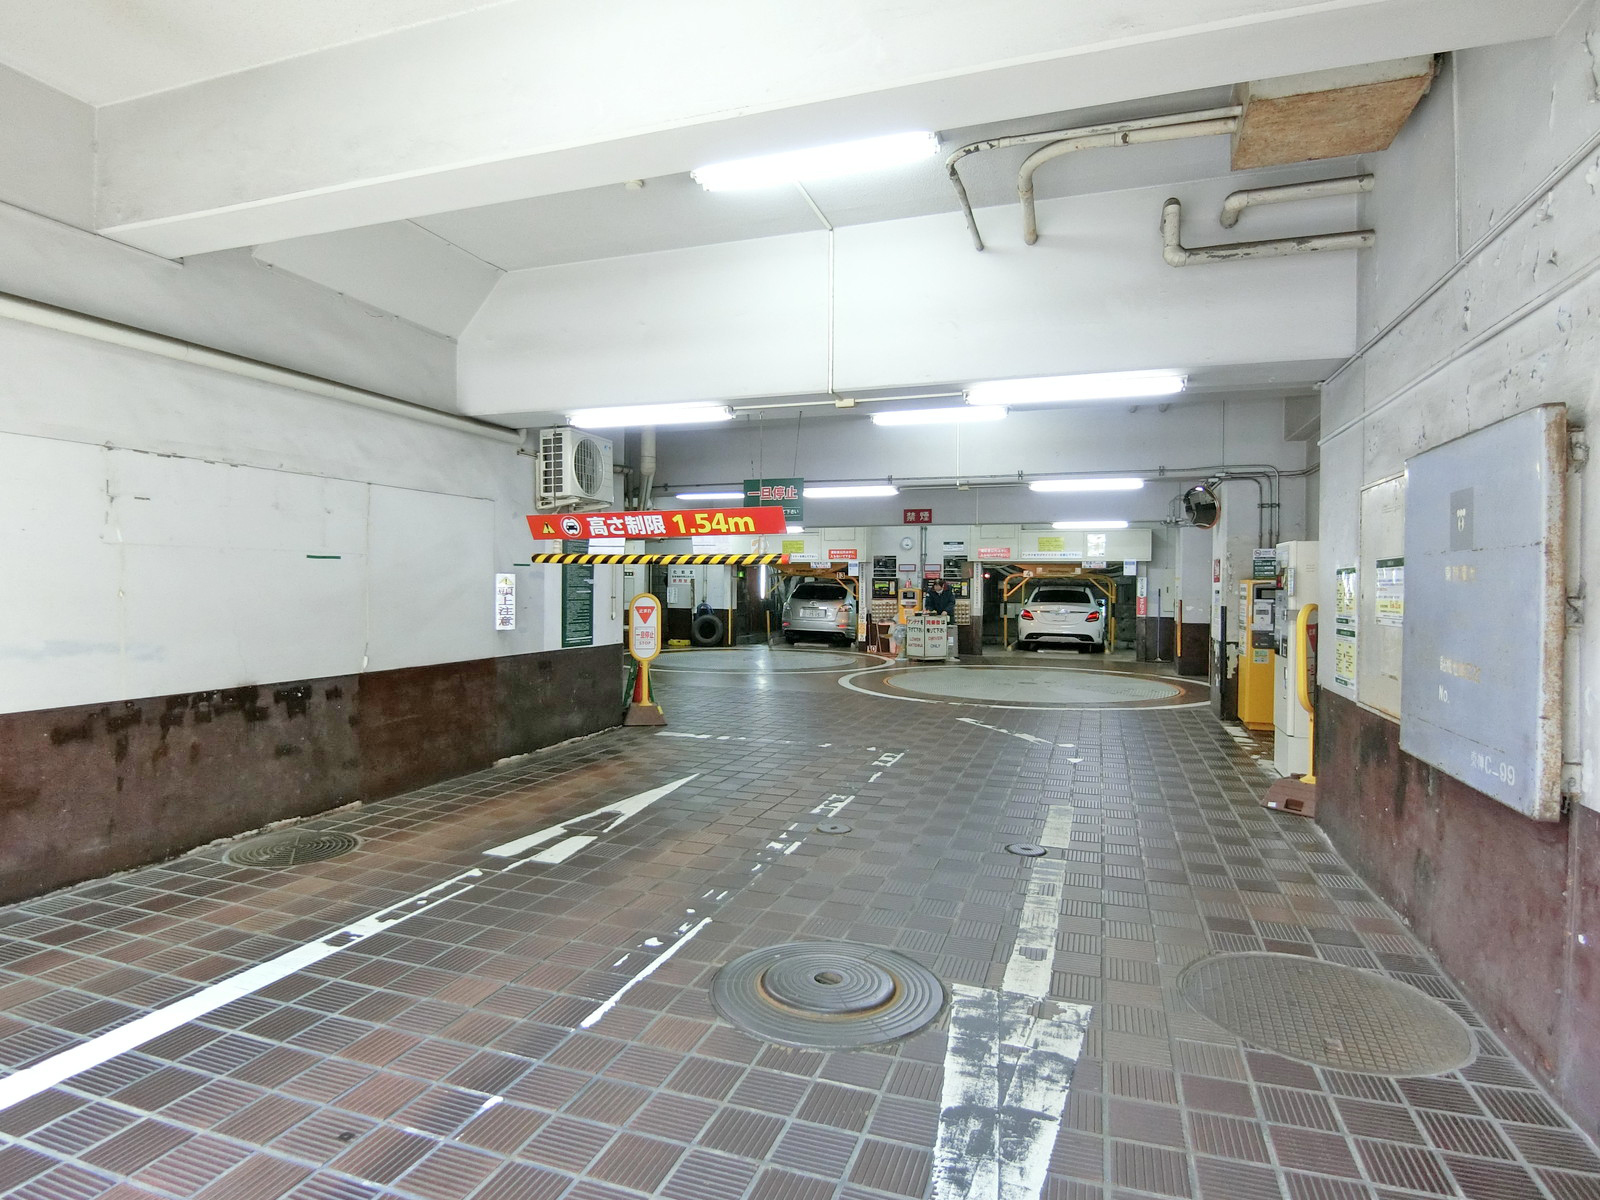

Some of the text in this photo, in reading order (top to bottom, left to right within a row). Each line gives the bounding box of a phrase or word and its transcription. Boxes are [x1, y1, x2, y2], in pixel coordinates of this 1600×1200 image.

[747, 485, 798, 500] 一旦停止
[586, 513, 756, 536] 高さ制限 1.54m
[906, 511, 930, 521] 禁煙
[498, 586, 514, 626] 頭上注意
[1438, 684, 1451, 704] No.
